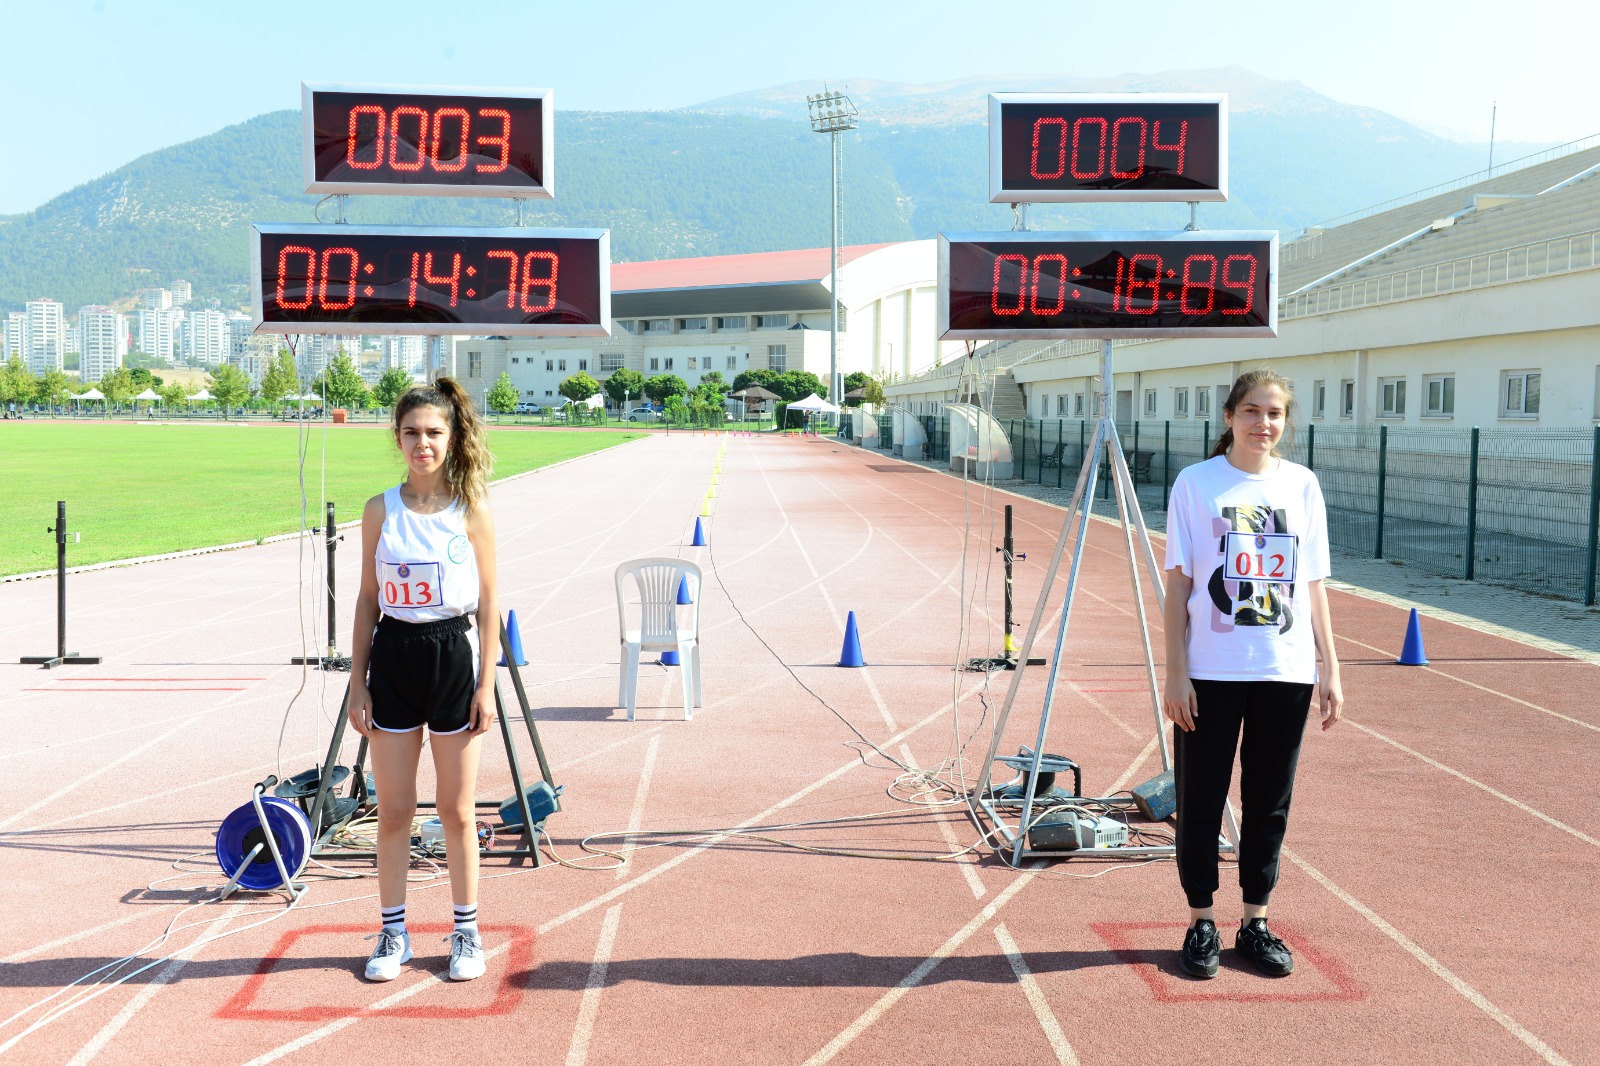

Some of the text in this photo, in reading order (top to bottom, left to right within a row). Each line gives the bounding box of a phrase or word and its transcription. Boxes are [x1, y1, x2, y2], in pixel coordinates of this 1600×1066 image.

[346, 105, 512, 173] 0003
[1030, 117, 1188, 180] 0004
[1235, 551, 1285, 577] 012
[385, 581, 433, 605] 013
